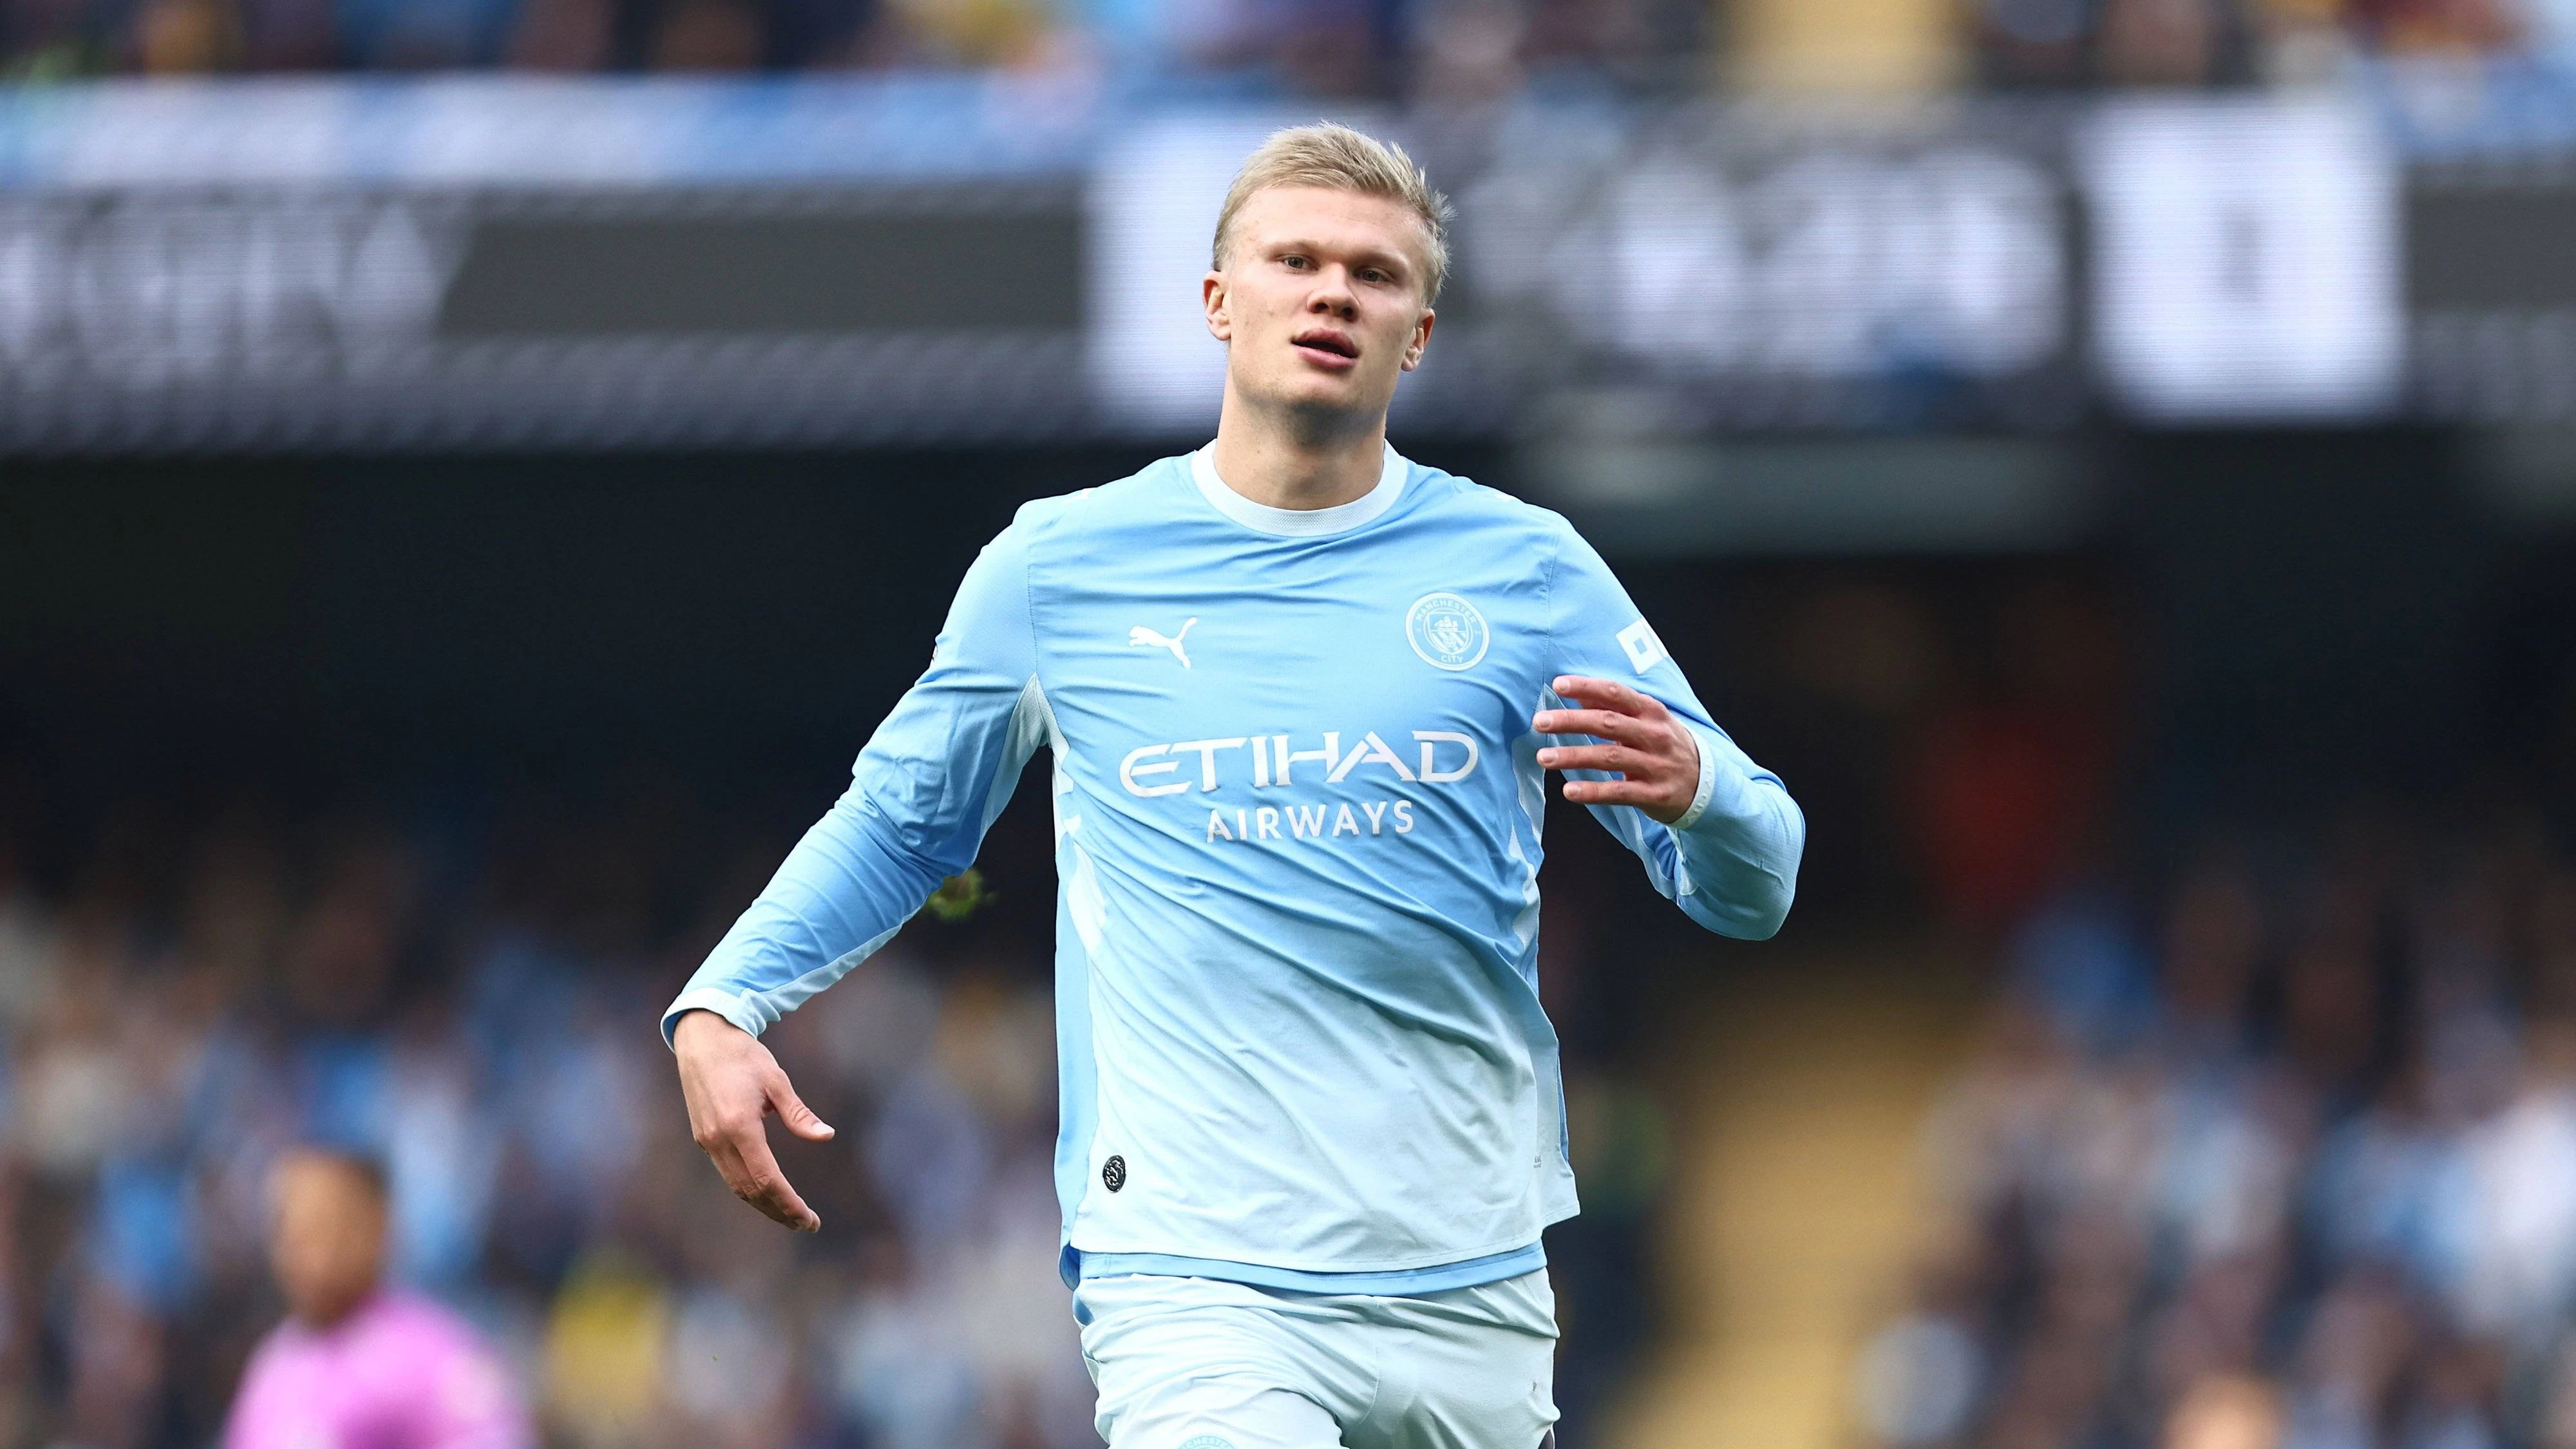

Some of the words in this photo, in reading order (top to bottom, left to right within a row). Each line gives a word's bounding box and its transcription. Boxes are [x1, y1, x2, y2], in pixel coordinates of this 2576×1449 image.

[1416, 598, 1476, 623] MANCHESTER
[1441, 654, 1464, 663] CITY
[1119, 730, 1479, 798] ETIHAD
[1207, 799, 1414, 843] AIRWAYS
